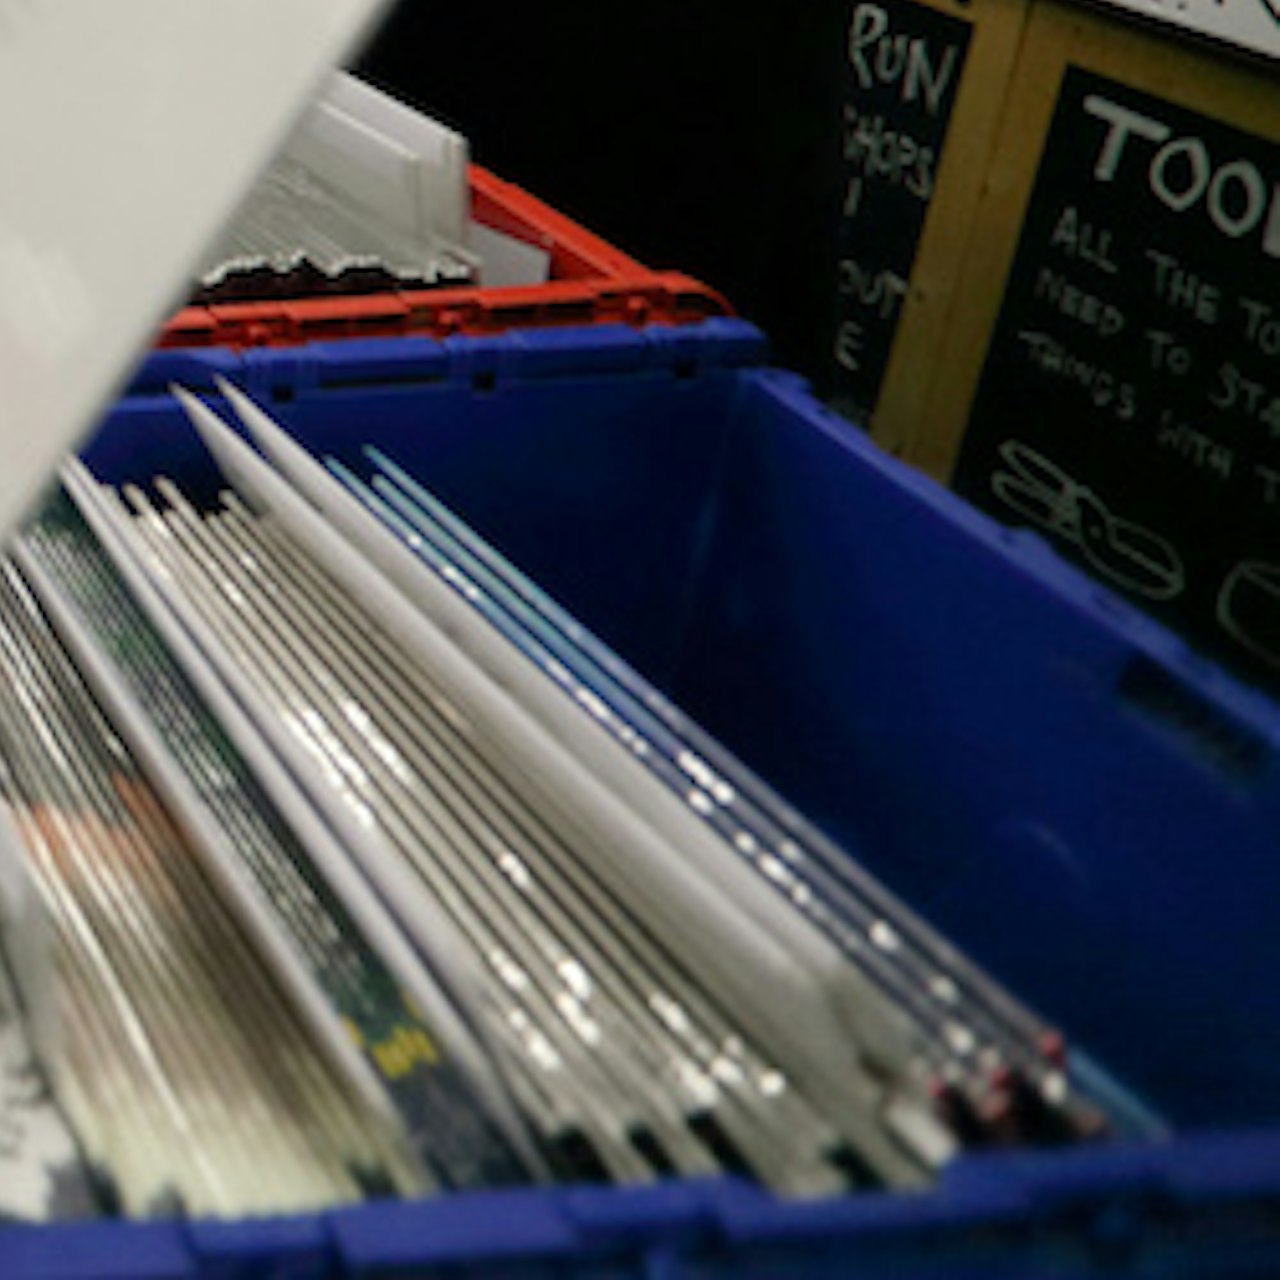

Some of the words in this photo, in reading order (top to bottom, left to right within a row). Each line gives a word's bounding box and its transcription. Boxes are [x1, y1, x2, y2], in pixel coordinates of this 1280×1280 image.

[1033, 266, 1127, 339] NEED
[1144, 327, 1192, 376] TO
[1048, 205, 1119, 275] ALL
[1143, 248, 1223, 327] THE
